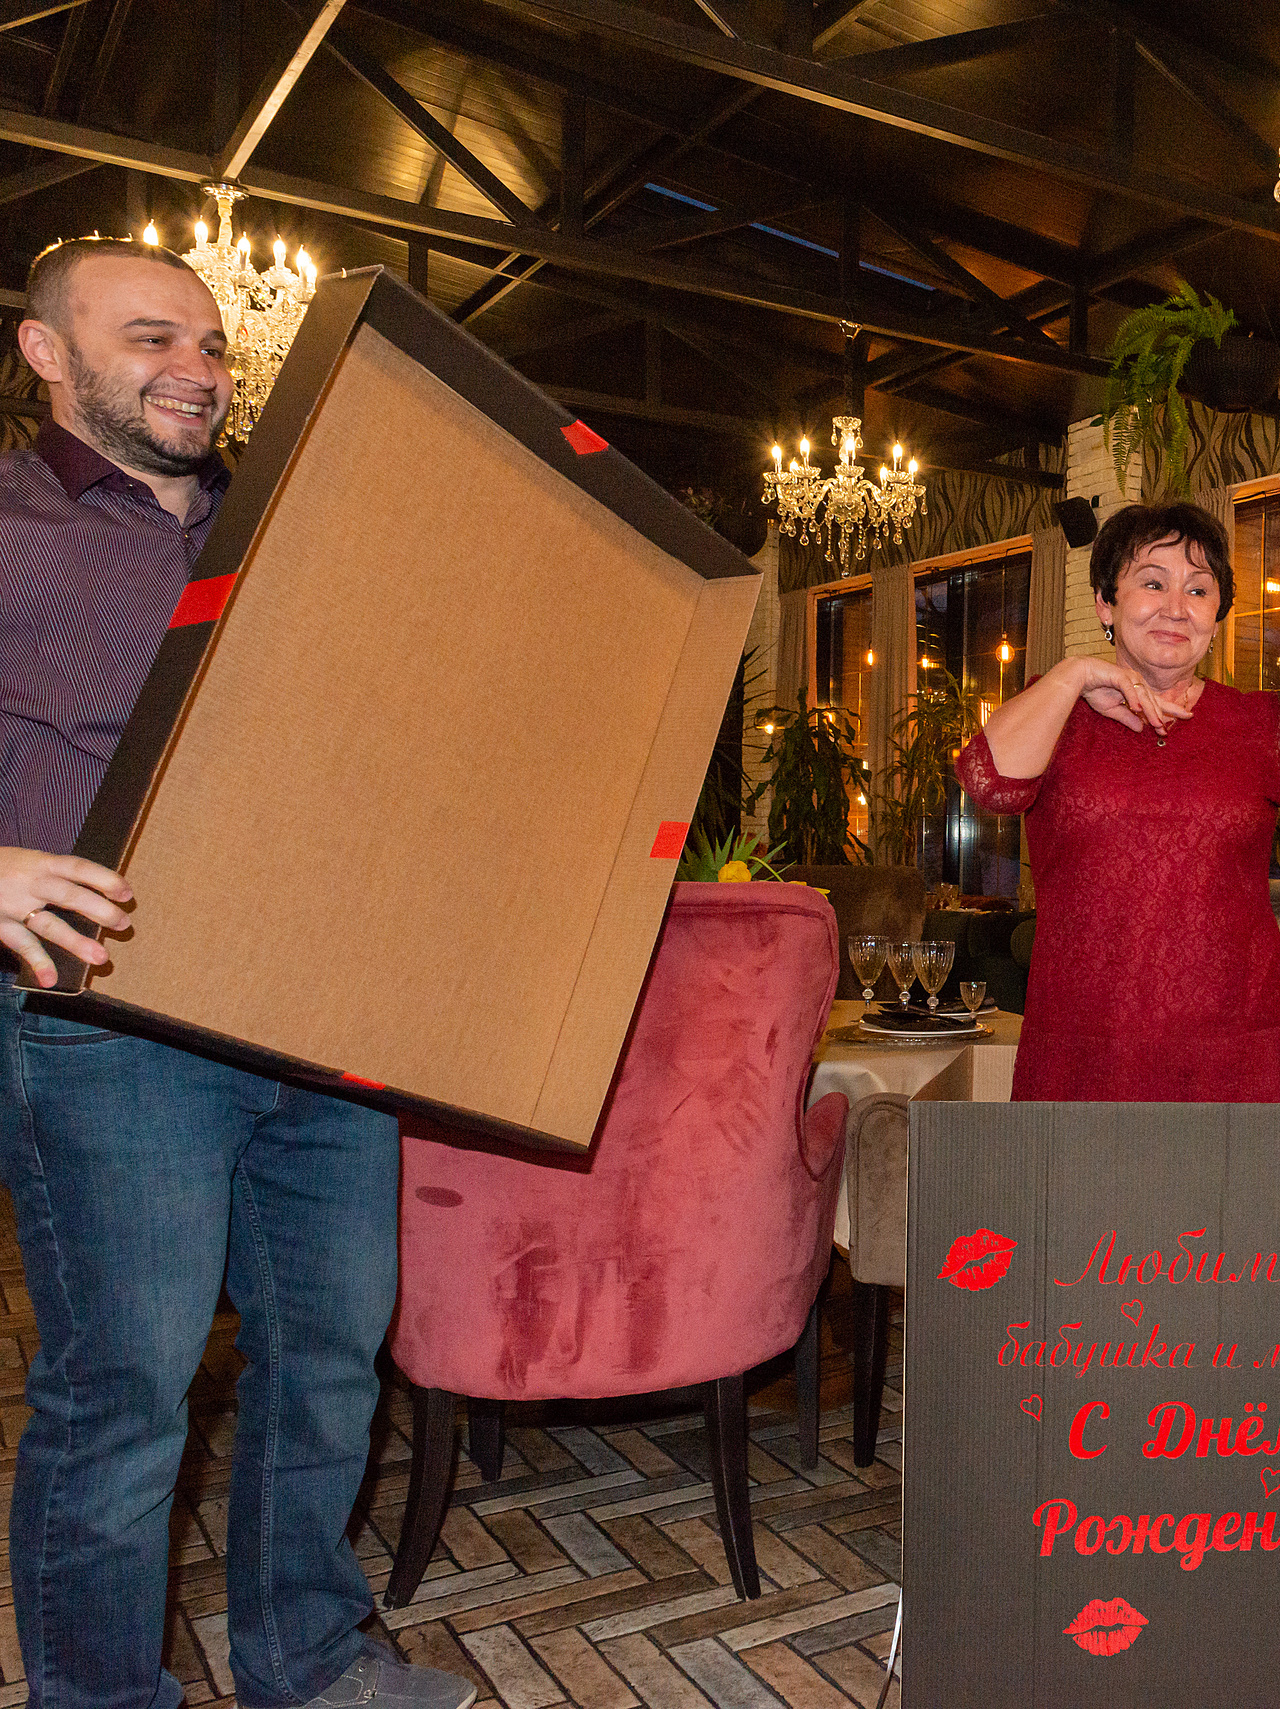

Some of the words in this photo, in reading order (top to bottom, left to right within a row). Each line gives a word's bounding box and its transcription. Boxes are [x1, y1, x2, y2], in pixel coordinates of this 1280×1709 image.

[997, 1320, 1196, 1379] бабушка
[1211, 1342, 1242, 1370] и
[1068, 1400, 1111, 1460] С
